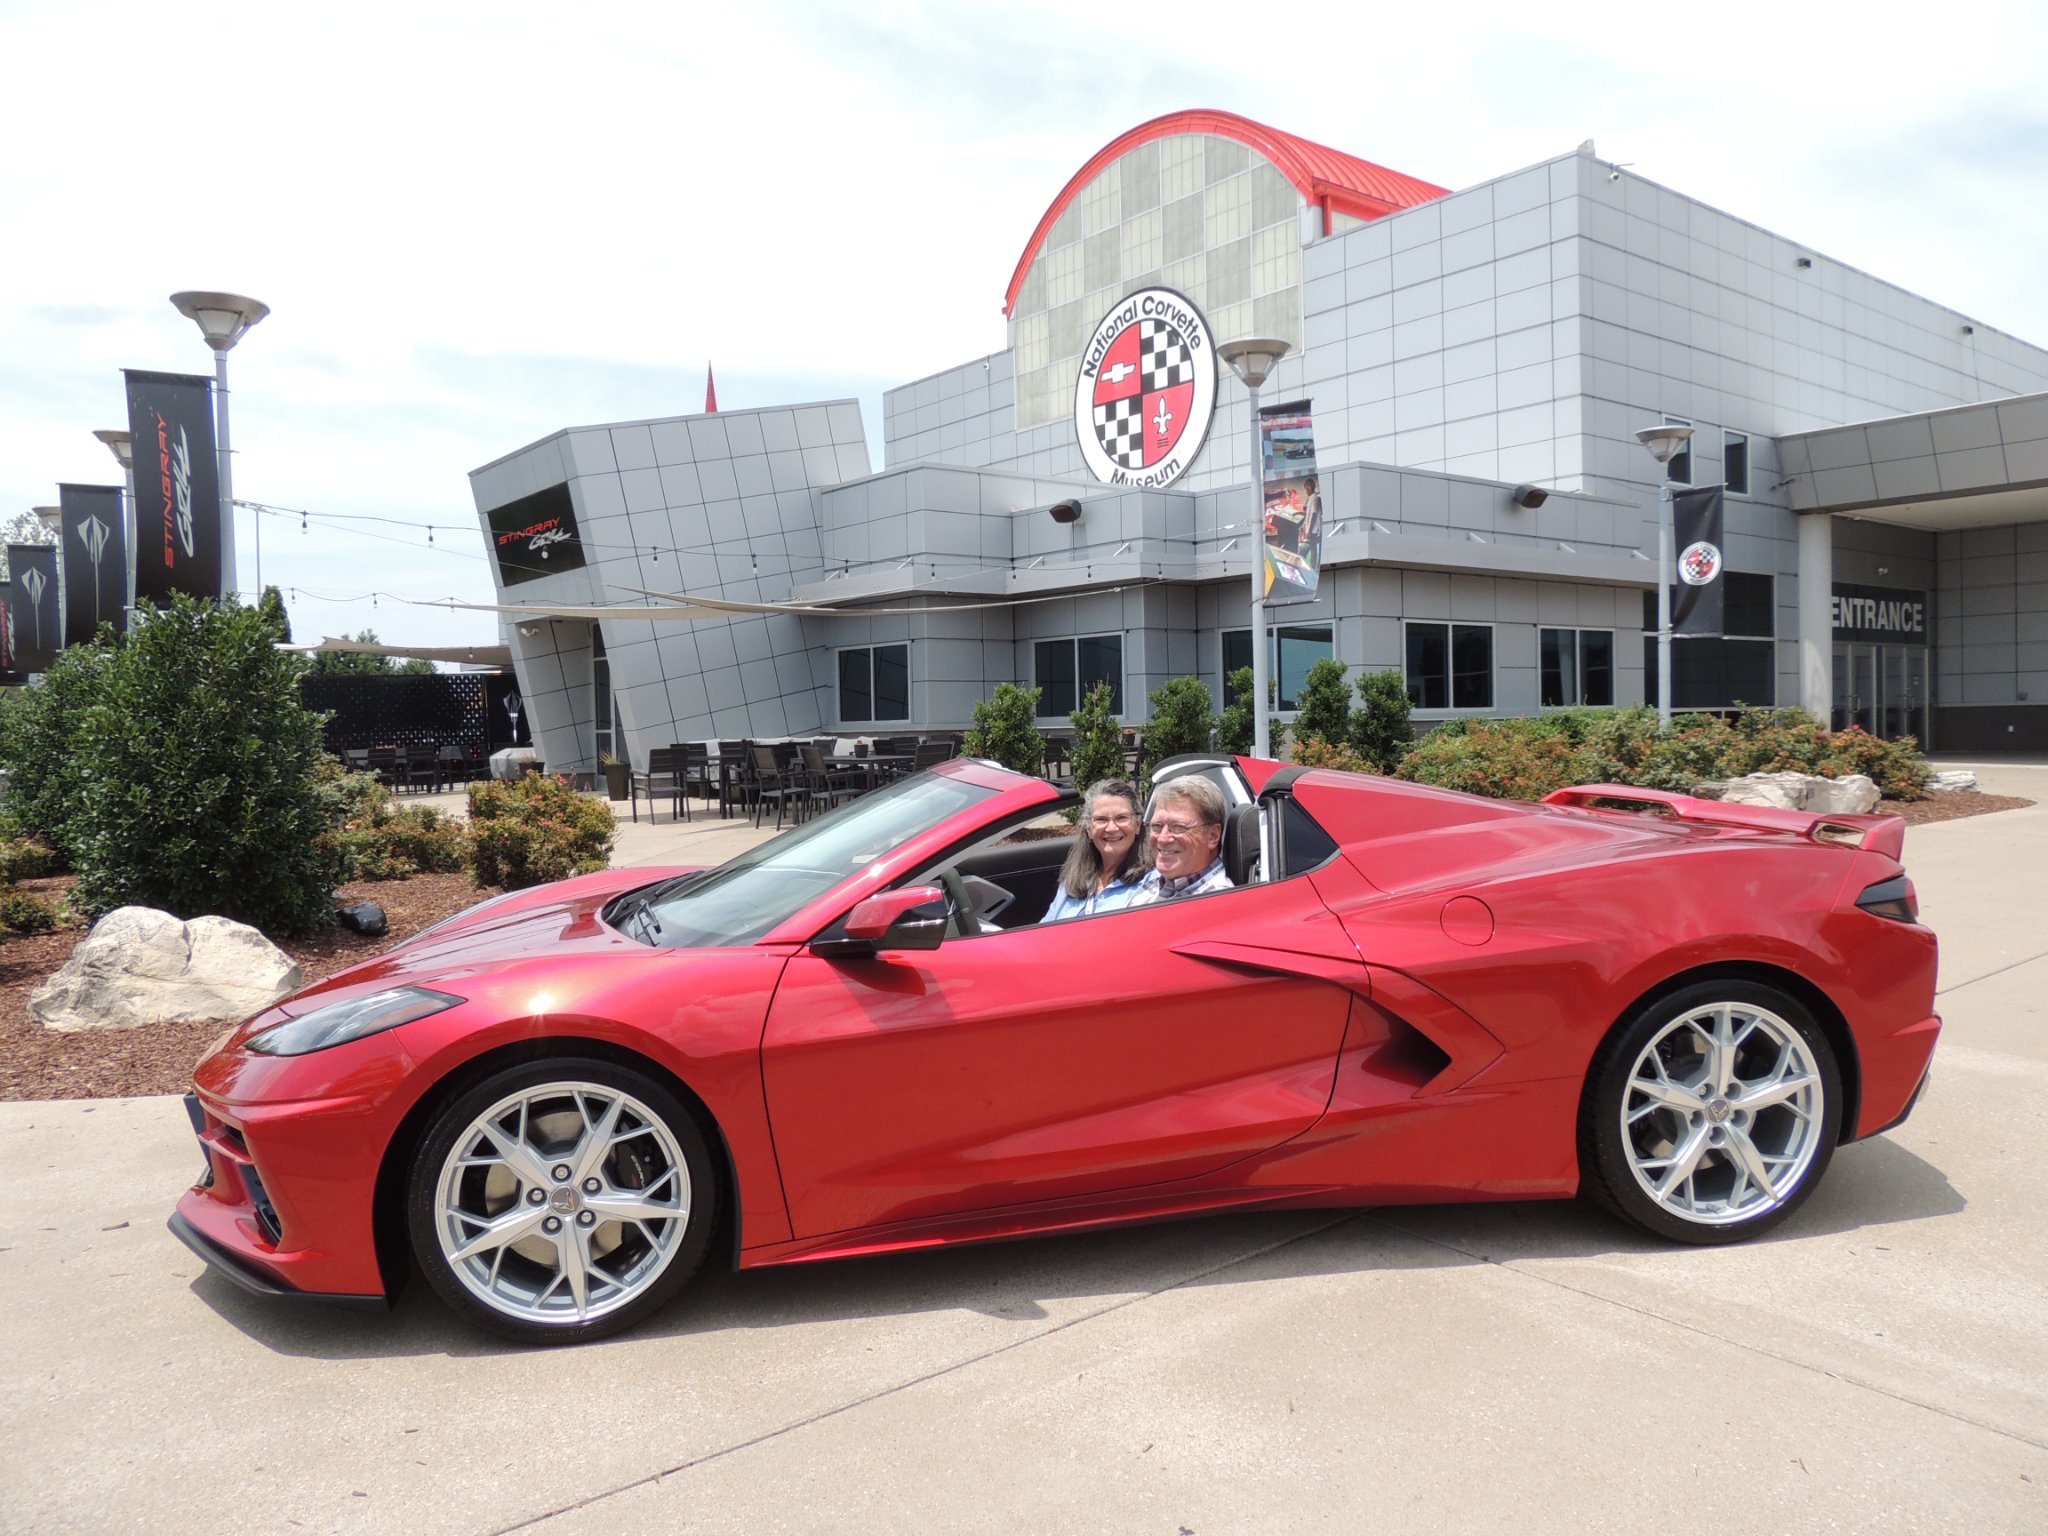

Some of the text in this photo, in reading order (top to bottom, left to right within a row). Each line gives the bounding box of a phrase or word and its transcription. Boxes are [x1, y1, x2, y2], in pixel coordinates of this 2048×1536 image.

[1083, 296, 1201, 379] National Corvette
[156, 411, 175, 569] STINGRAY
[1110, 458, 1181, 488] Museum
[498, 516, 561, 545] STINGRAY
[1832, 596, 1923, 632] ENTRANCE
